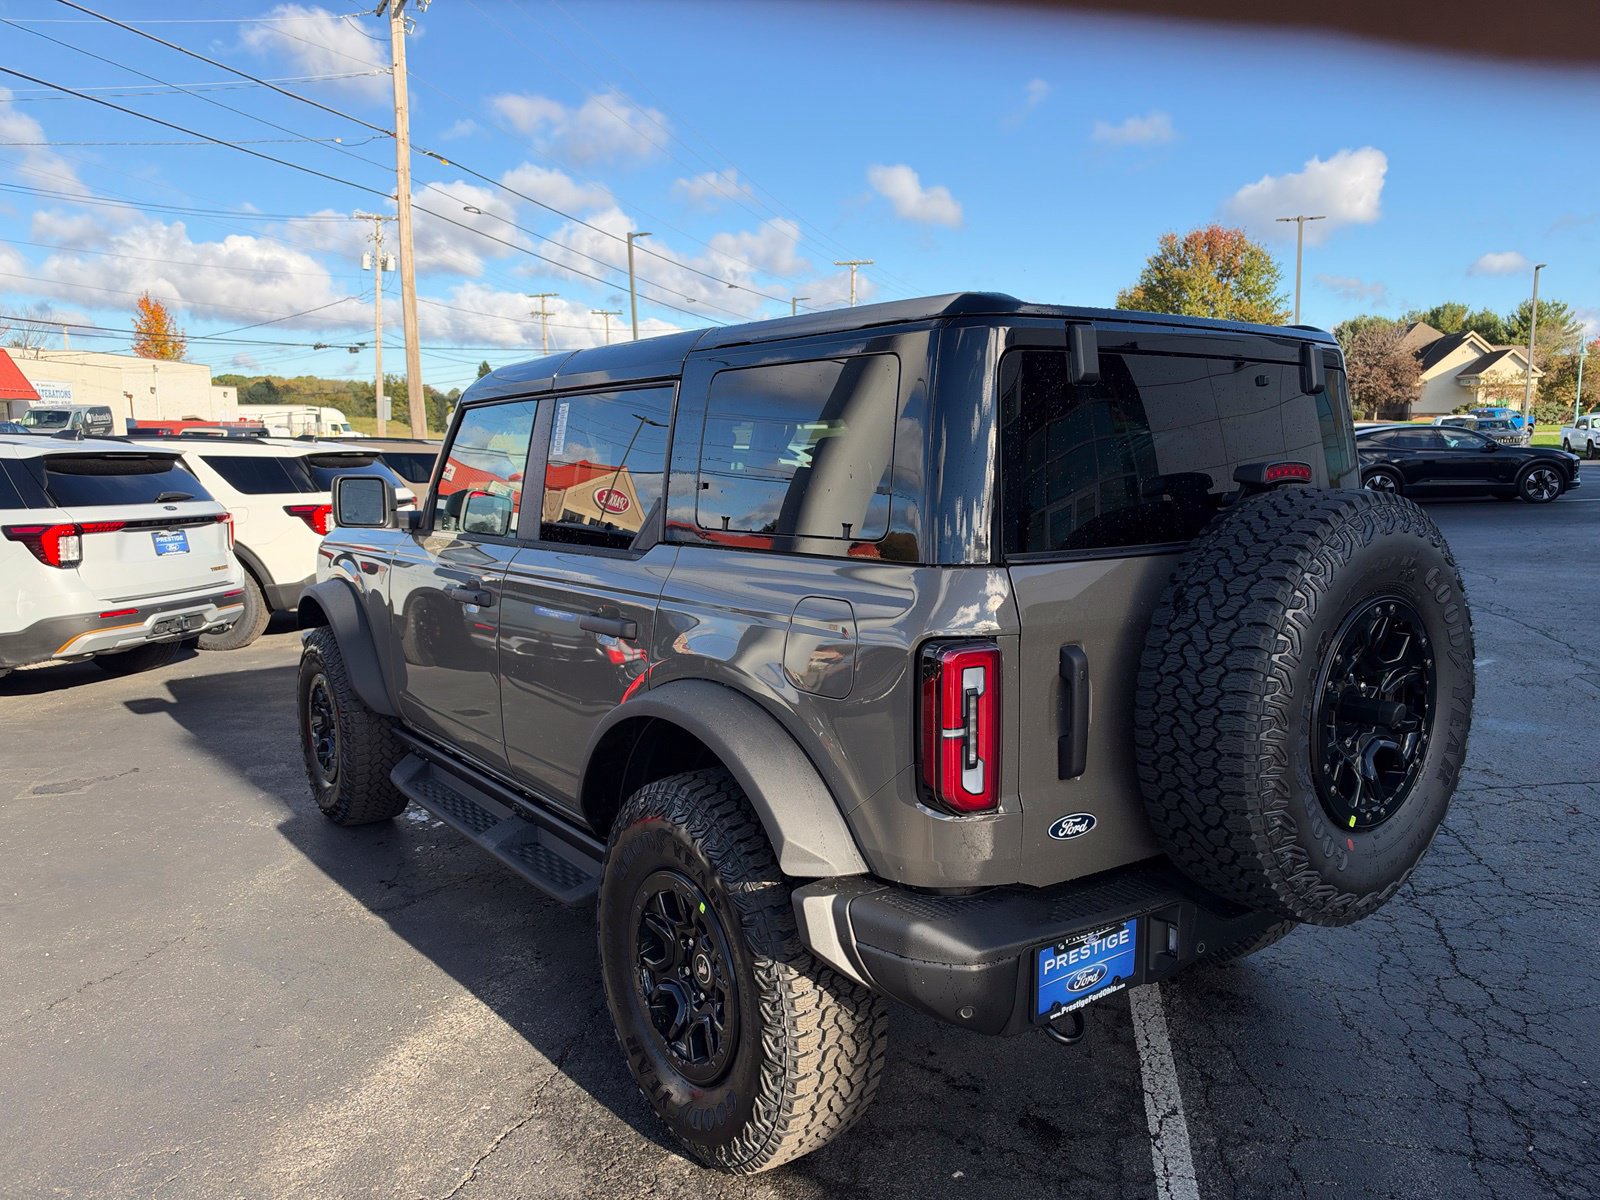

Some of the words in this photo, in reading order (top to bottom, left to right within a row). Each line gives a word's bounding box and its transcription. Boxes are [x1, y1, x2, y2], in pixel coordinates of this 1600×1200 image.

[38, 389, 71, 399] LTERATIONS
[1058, 817, 1089, 837] Ford
[1044, 929, 1130, 975] PRESTIGE
[1073, 968, 1100, 990] Ford
[1049, 983, 1126, 1020] www.PrestigeFordOhio.com
